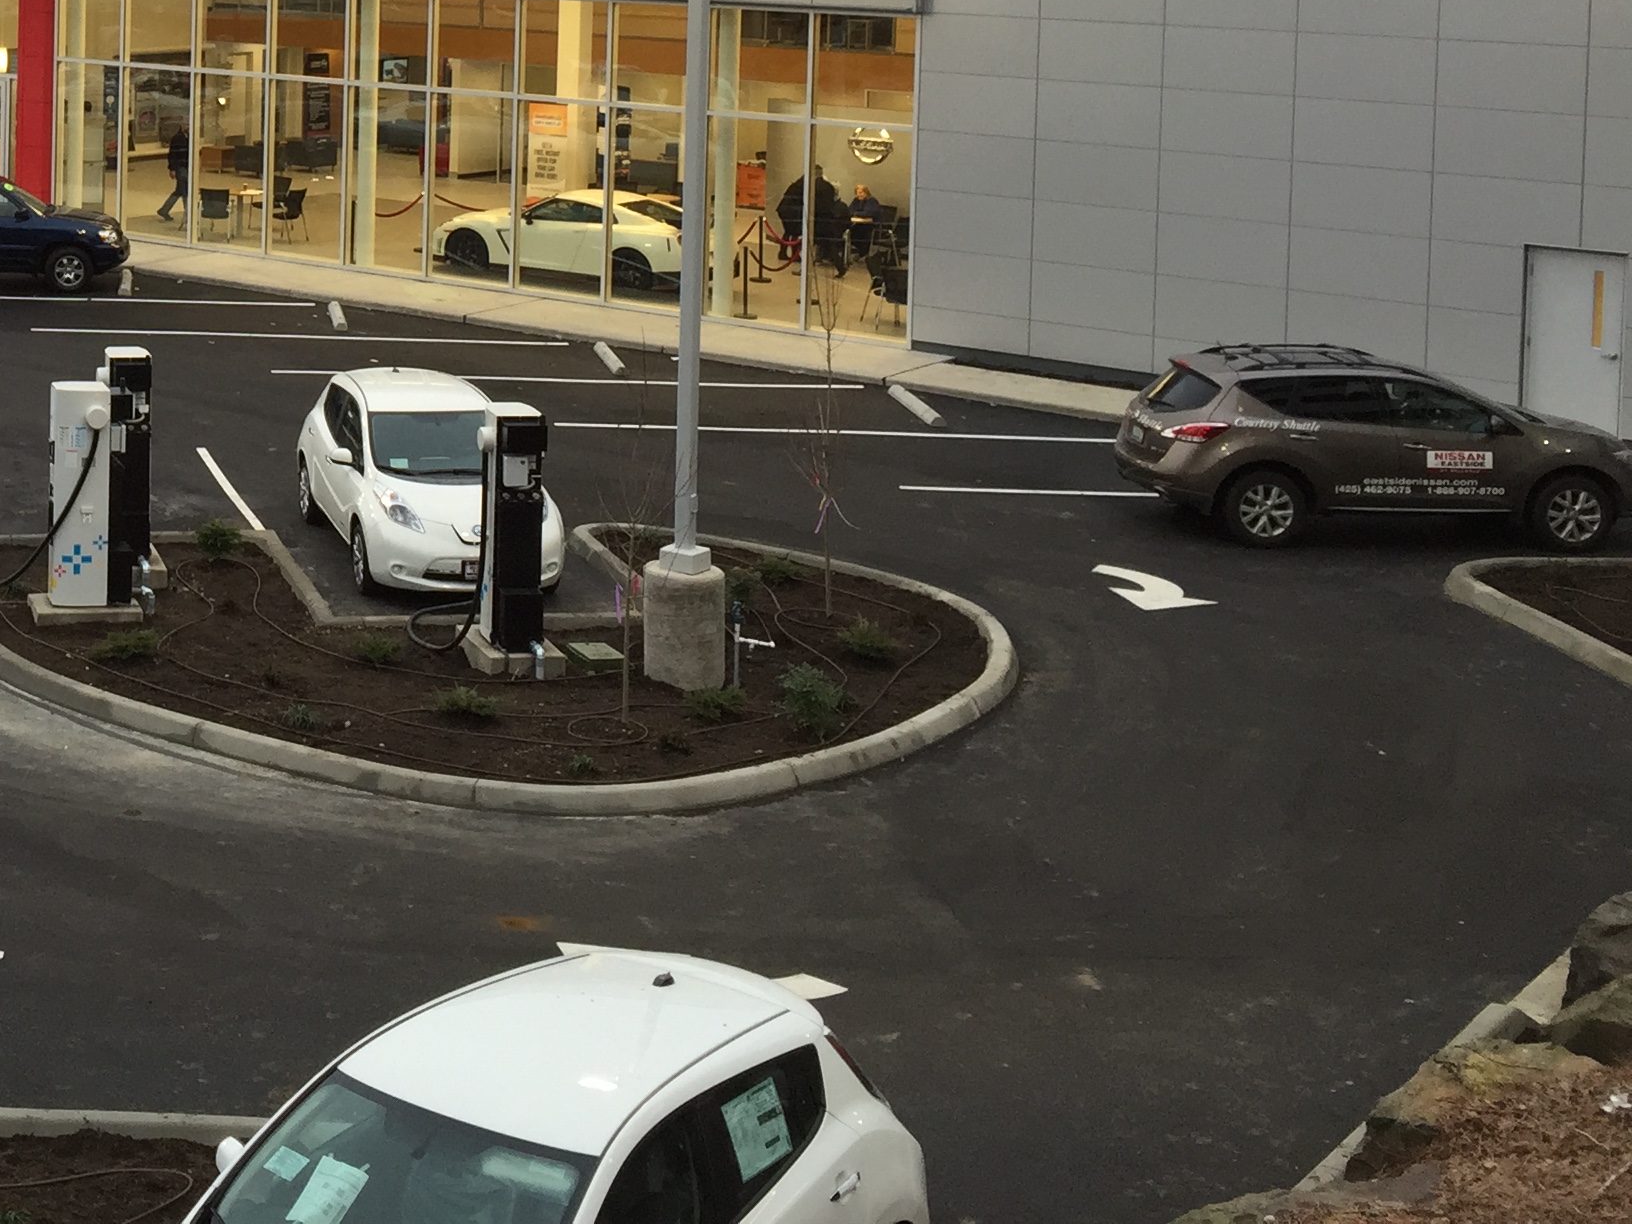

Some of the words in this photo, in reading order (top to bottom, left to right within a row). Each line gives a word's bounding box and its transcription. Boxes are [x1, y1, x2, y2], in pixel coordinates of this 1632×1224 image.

[1234, 417, 1280, 432] Courtesy
[1282, 418, 1321, 432] Shuttle
[1434, 452, 1486, 461] NISSAN
[1363, 476, 1478, 486] eastsidenissan.com
